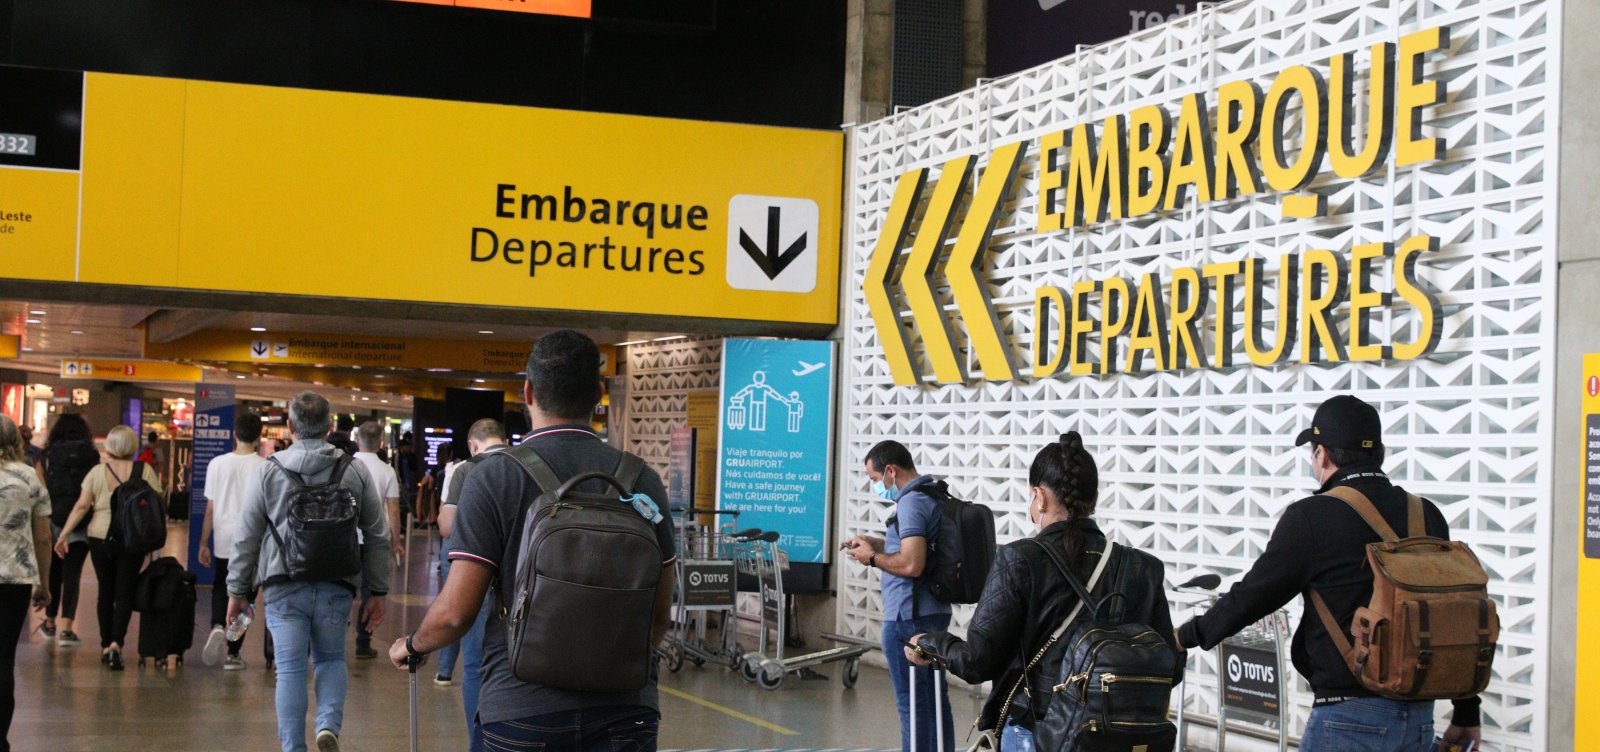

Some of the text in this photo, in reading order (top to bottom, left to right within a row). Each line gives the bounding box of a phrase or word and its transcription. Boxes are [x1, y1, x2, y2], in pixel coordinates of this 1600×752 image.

[1037, 27, 1448, 232] EMBARQUE
[495, 183, 709, 239] Embarque
[469, 227, 706, 277] Departures
[1033, 235, 1443, 378] DEPARTURES
[289, 338, 405, 350] Embarque internacional
[289, 350, 351, 360] International
[127, 365, 134, 375] 3
[726, 447, 804, 459] Viaje tranquilo por
[725, 458, 785, 468] GRUAIRPORT.
[725, 469, 821, 481] Nós cuidamos de você!
[724, 480, 746, 489] Have
[755, 481, 773, 490] safe
[774, 482, 805, 493] journey
[724, 491, 743, 500] with
[724, 502, 737, 511] We
[753, 503, 772, 512] here
[774, 503, 786, 512] for
[787, 505, 807, 515] you!
[703, 573, 729, 583] TOTVS
[1242, 661, 1275, 684] TOTVS
